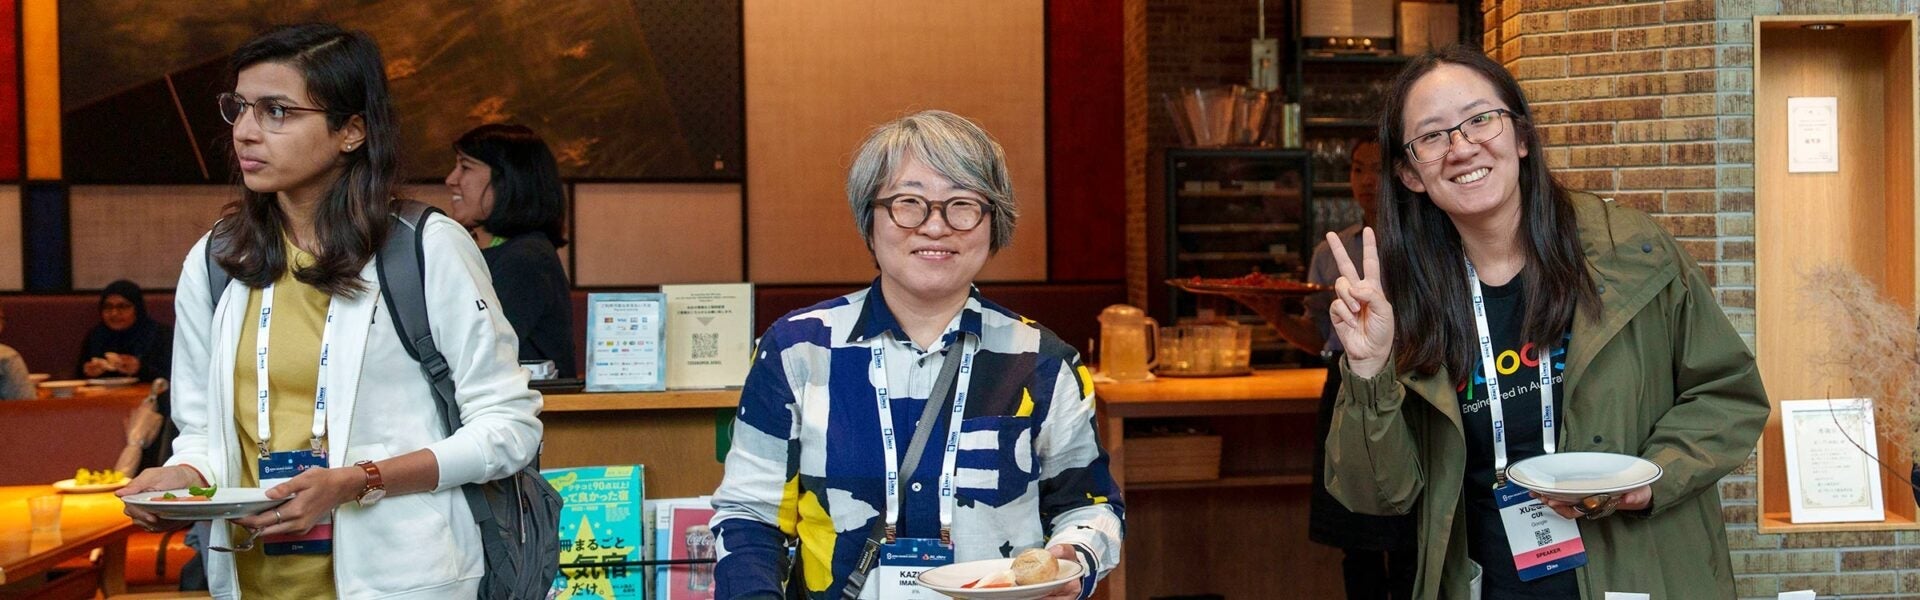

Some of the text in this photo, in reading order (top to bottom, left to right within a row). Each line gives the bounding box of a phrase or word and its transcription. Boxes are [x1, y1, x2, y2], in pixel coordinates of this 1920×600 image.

[1462, 387, 1516, 413] Engineed
[1518, 385, 1528, 395] in
[1536, 548, 1561, 558] SPEAKER
